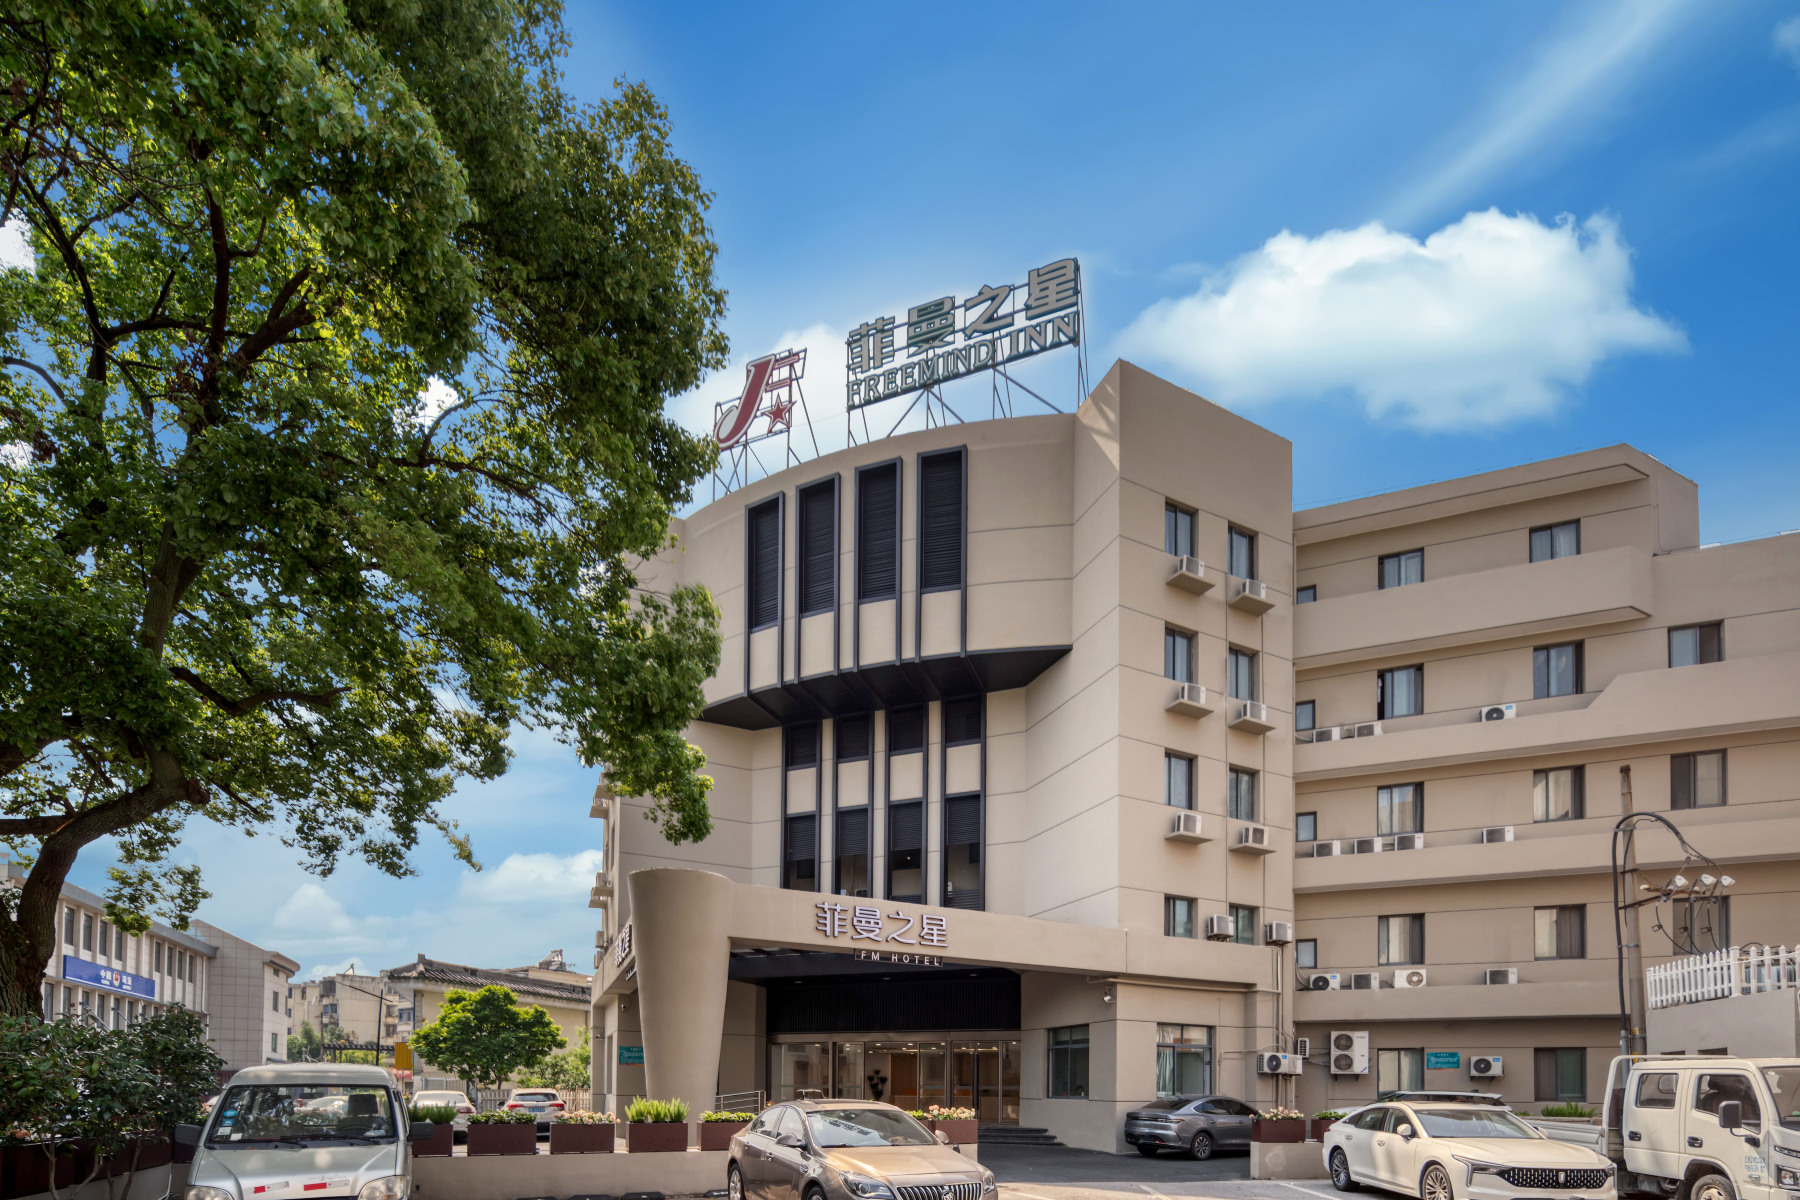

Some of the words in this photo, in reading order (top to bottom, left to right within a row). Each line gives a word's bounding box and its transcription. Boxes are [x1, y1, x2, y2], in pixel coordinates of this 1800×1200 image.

[847, 258, 1078, 374] 菲曼之星
[847, 339, 994, 406] FREEMIND
[1007, 309, 1078, 360] INN
[816, 901, 949, 947] 菲曼之星
[861, 950, 880, 961] FM
[891, 953, 939, 966] HOTEL
